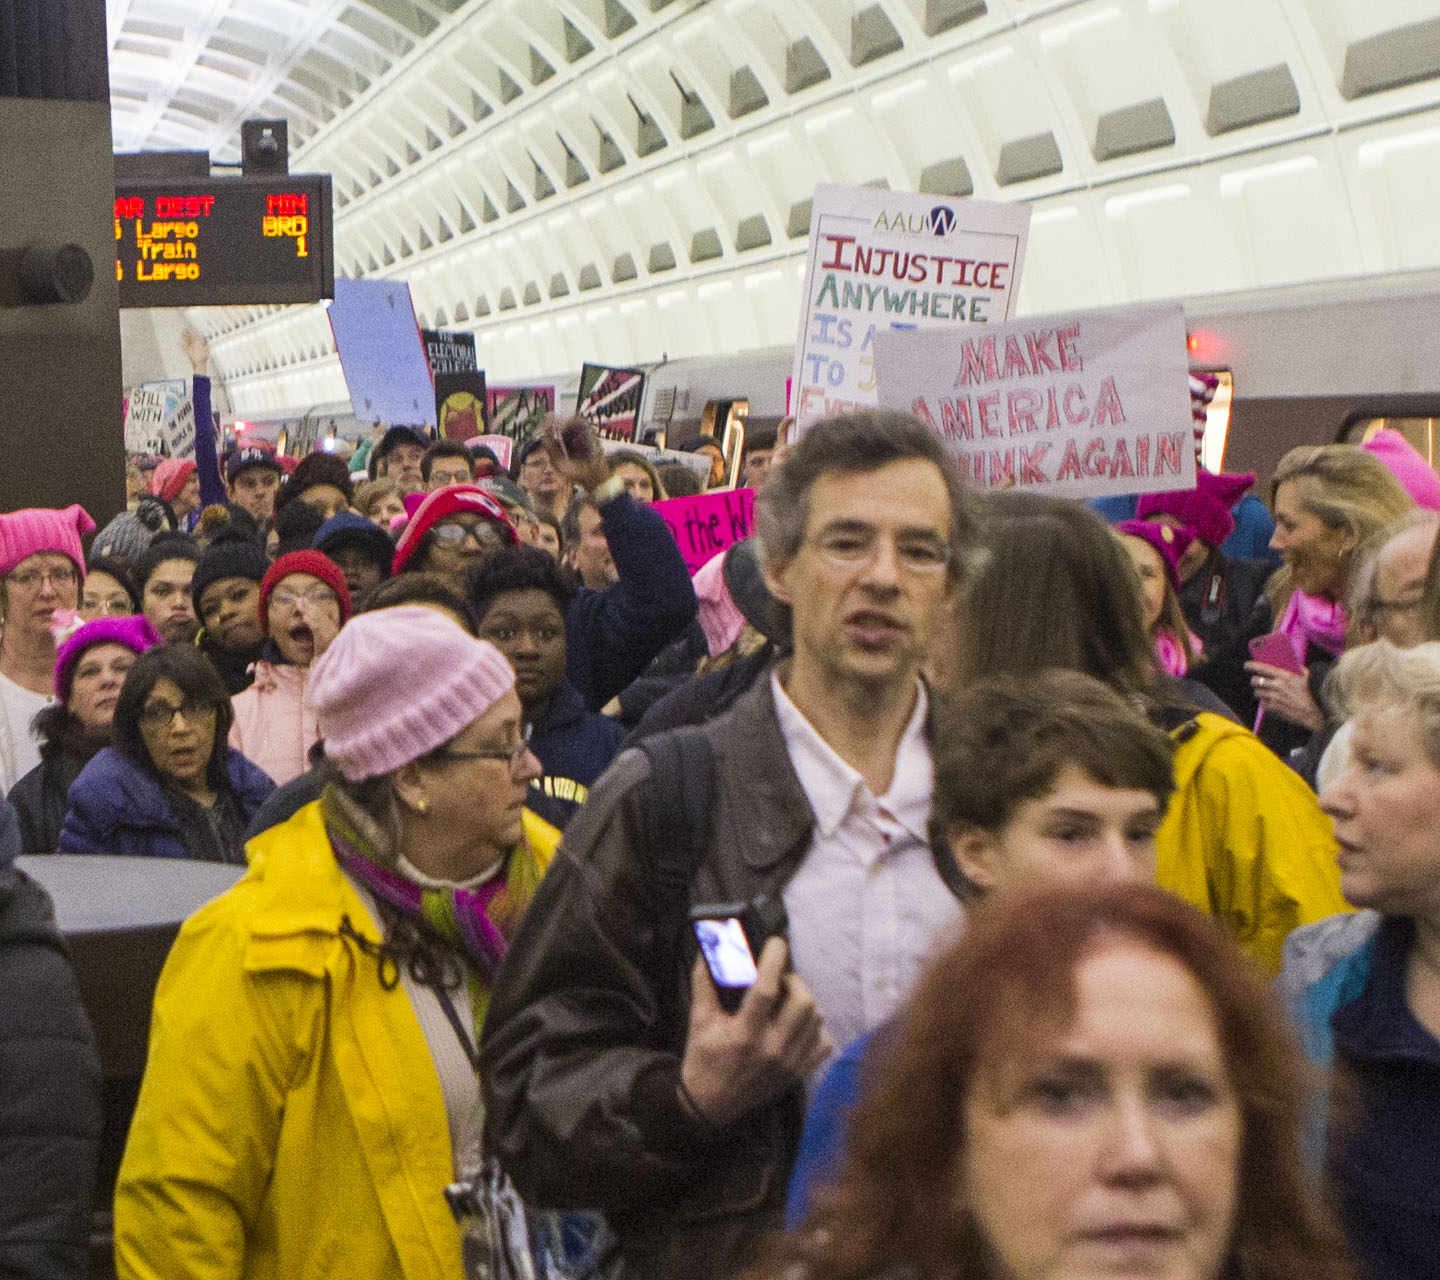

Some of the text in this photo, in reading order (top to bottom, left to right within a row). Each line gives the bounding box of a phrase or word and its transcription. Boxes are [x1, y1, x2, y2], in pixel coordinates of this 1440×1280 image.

[113, 193, 308, 218] AR DEST MIN
[873, 205, 957, 237] AAUW
[135, 215, 308, 240] Largo BRD
[136, 235, 308, 260] Train 1
[136, 259, 201, 281] Largo
[815, 272, 991, 323] ANYWHERE
[811, 312, 853, 349] IS
[806, 352, 845, 387] TO
[953, 320, 1084, 388] MAKE
[131, 407, 163, 423] WITH
[1056, 431, 1187, 482] AGAIN
[683, 505, 724, 555] the
